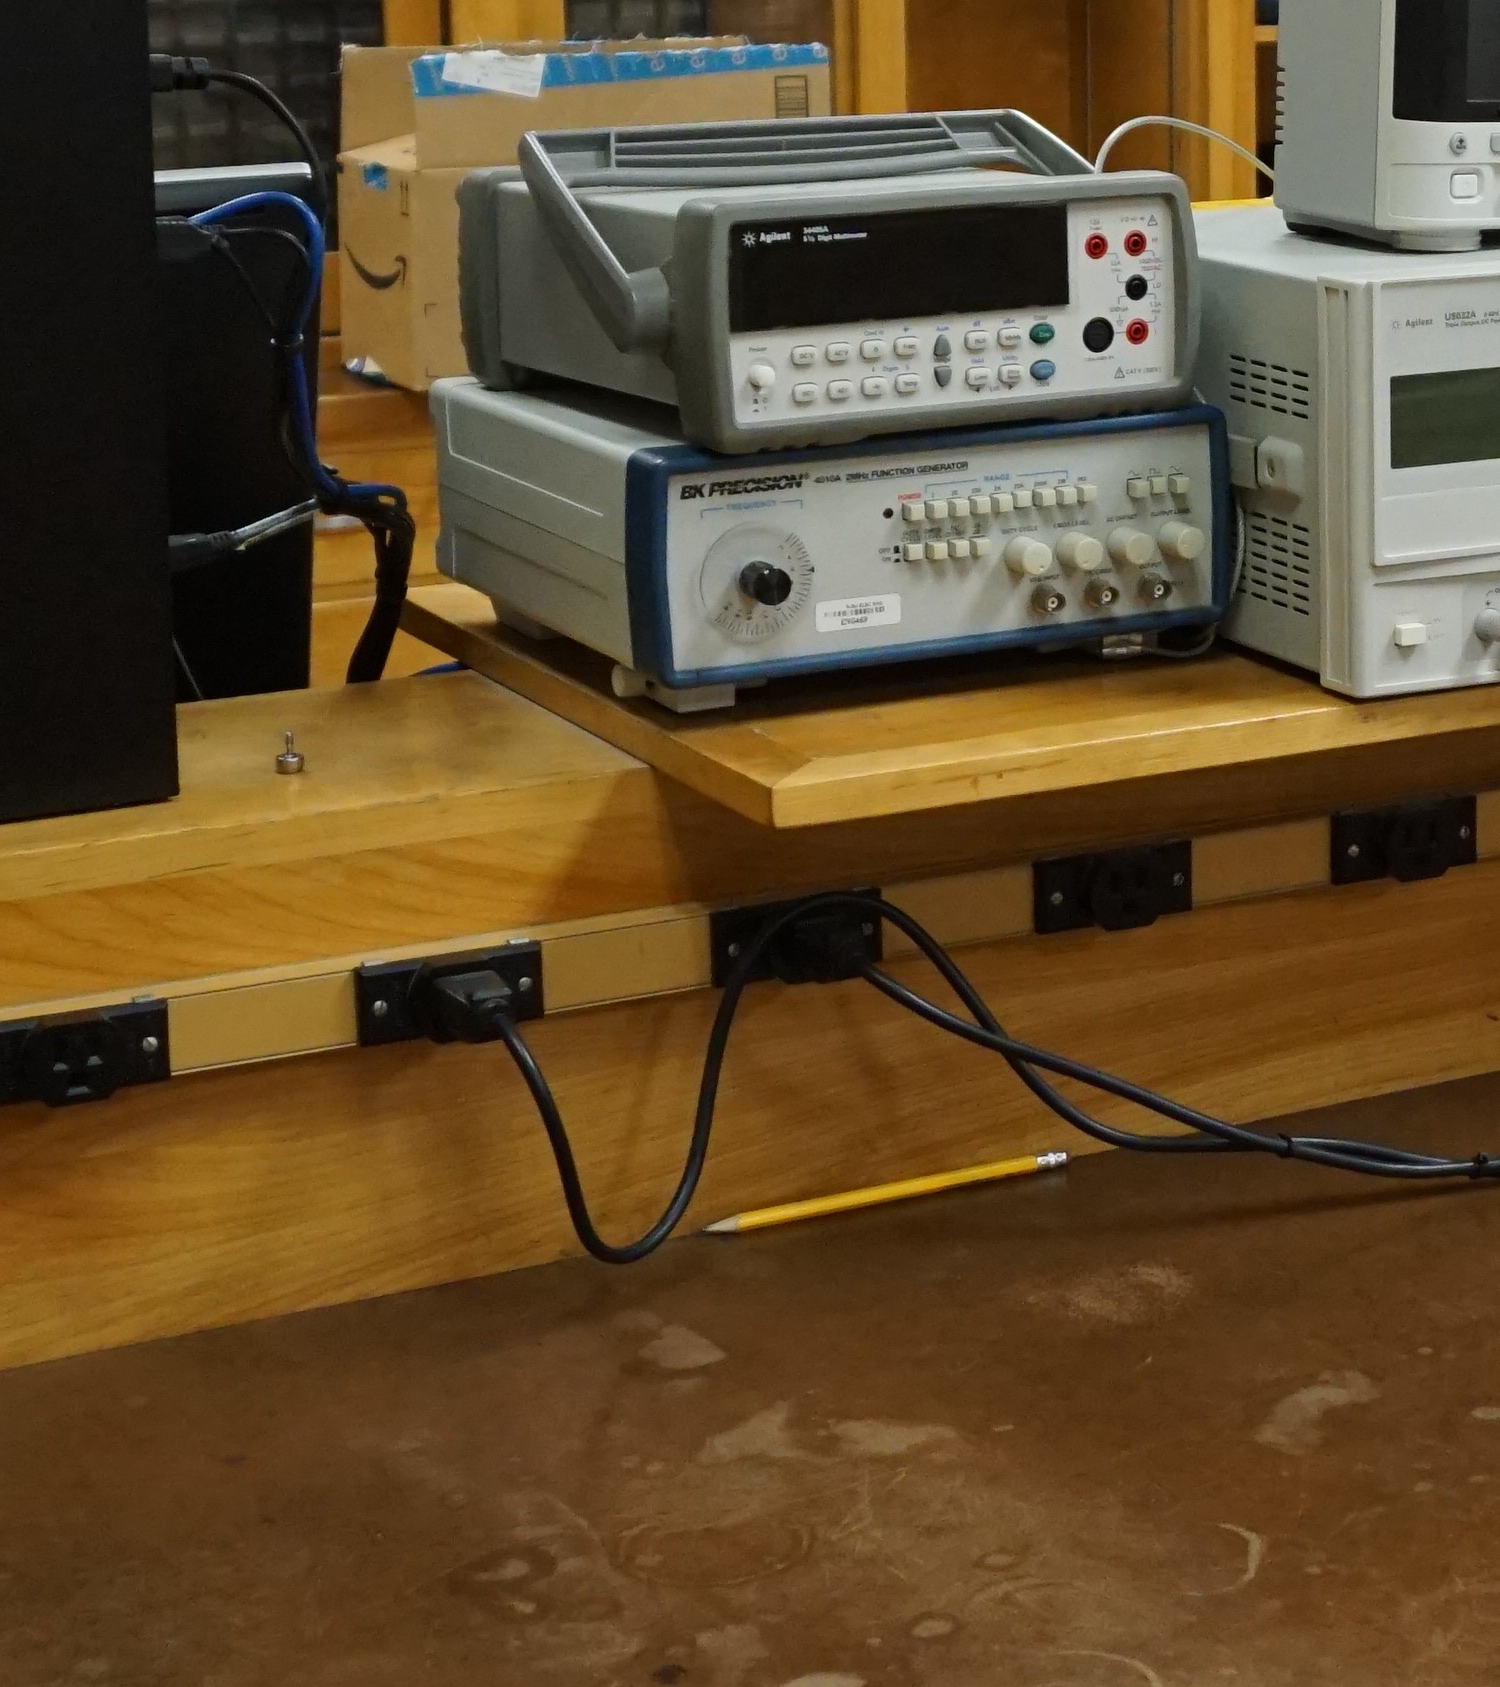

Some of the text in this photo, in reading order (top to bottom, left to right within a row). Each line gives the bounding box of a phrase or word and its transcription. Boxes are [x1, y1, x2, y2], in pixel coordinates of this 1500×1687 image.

[759, 231, 791, 243] Agilent
[1405, 318, 1433, 328] Agilent
[680, 482, 705, 500] BK
[708, 474, 804, 497] PRECISION
[871, 467, 915, 478] FUNCTION
[917, 461, 968, 474] GENERATOR
[983, 473, 1010, 482] RANGE
